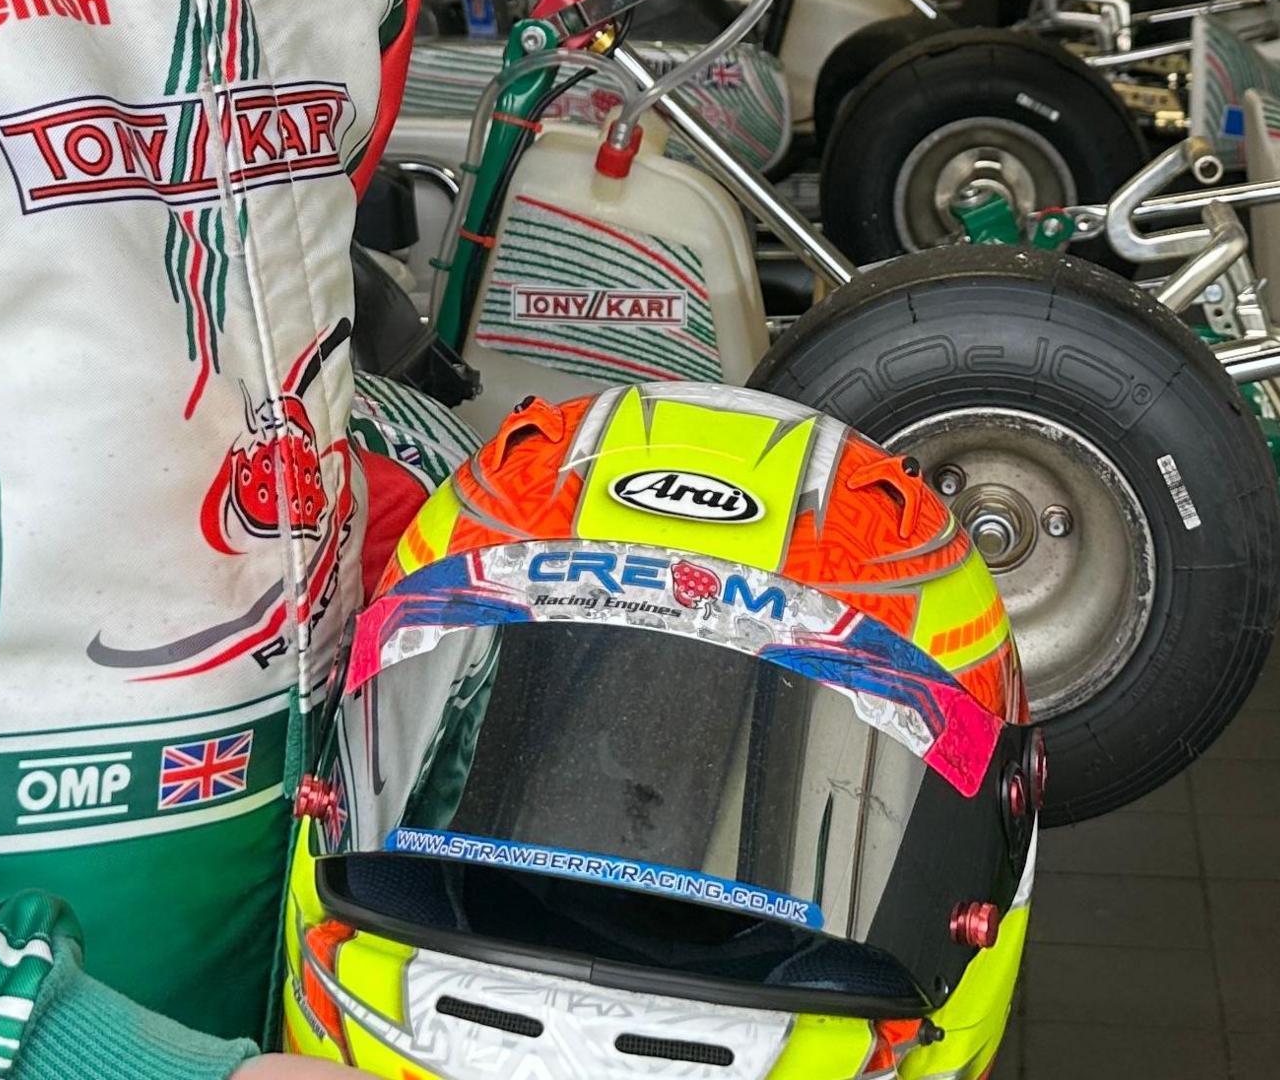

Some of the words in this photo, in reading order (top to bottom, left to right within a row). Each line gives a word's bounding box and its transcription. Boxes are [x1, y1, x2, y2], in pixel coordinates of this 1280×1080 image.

[517, 291, 589, 315] TONY
[606, 294, 681, 317] KART
[621, 474, 743, 512] Arai
[534, 594, 598, 609] Racing
[603, 597, 683, 618] Engines
[17, 763, 131, 812] OMP
[396, 830, 809, 921] WWW.STRAWBERRYRACING.CO.UK
